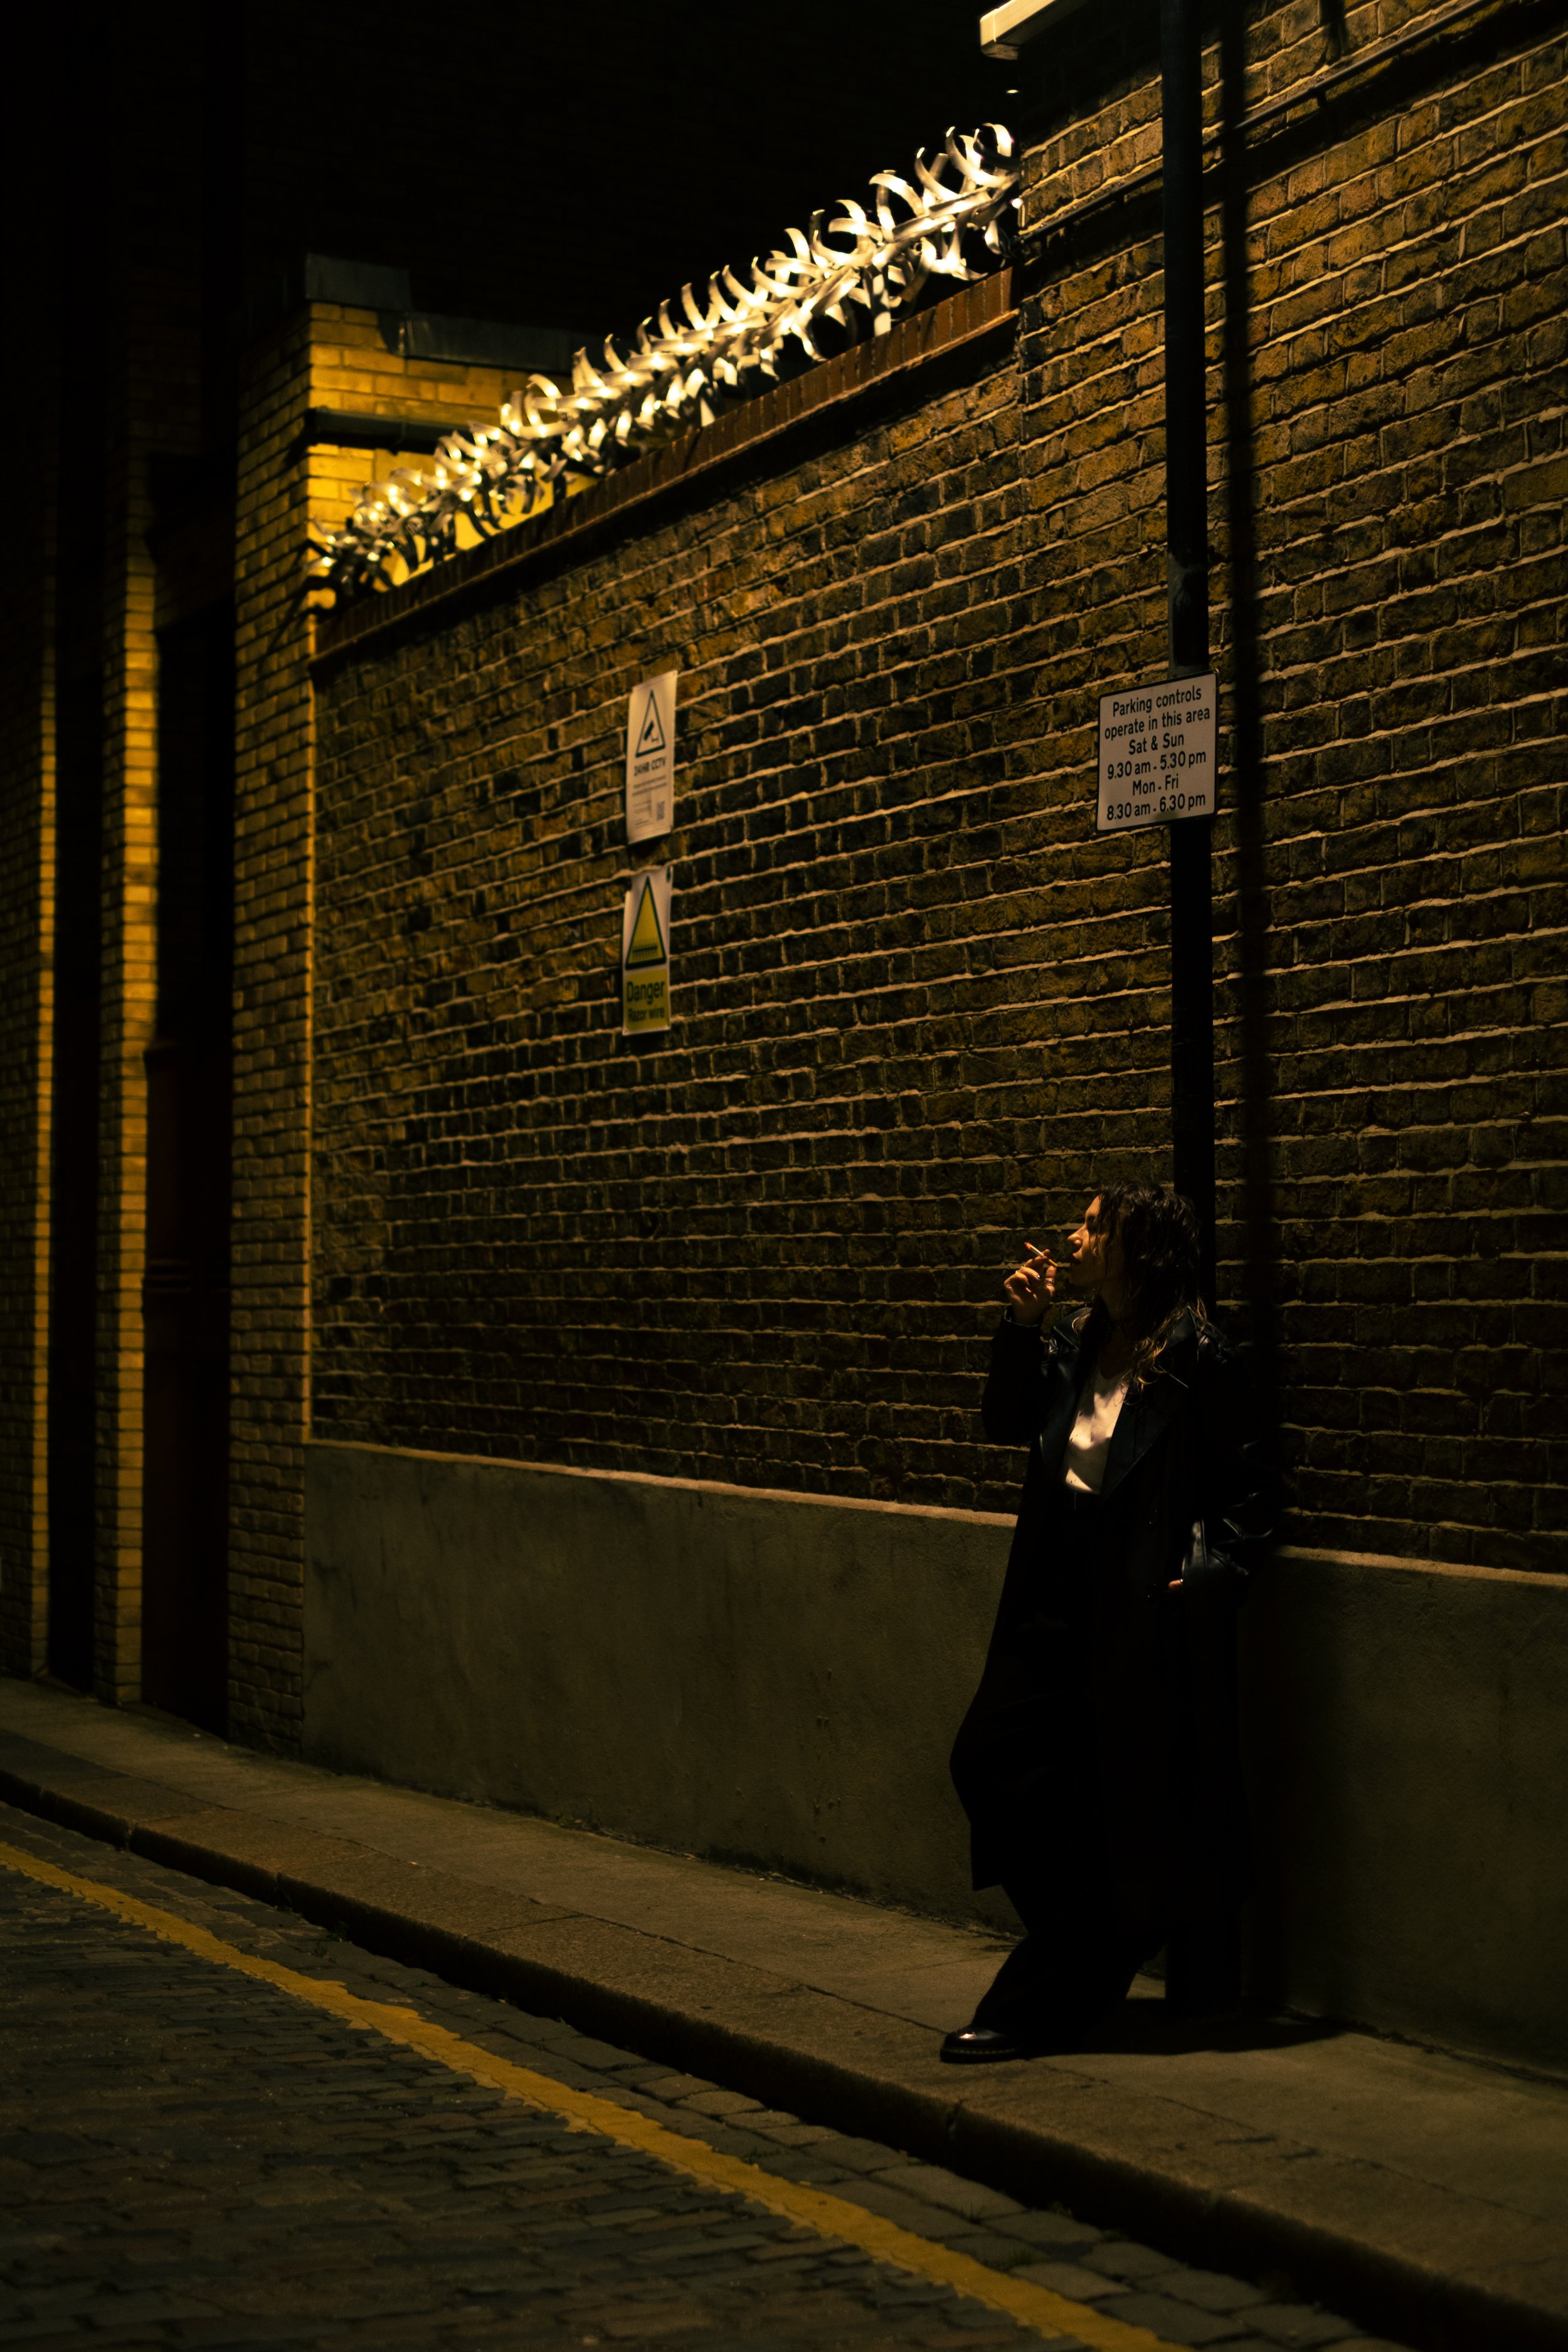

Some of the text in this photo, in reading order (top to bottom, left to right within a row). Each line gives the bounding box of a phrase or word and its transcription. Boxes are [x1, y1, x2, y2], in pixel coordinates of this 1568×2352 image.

[1113, 686, 1202, 717] Parking controls
[1104, 707, 1210, 741] operate in this area
[1129, 733, 1184, 755] Sat & Sun
[652, 756, 667, 771] CCTV
[1108, 761, 1131, 780] 9.30
[1135, 761, 1150, 775] am
[1160, 751, 1185, 770] 5.30
[1189, 751, 1206, 768] pm
[1133, 780, 1155, 795] Mon
[1165, 774, 1179, 790] Fri
[1107, 802, 1131, 820] 8.30
[1135, 803, 1150, 817] am
[1160, 793, 1185, 812] 6.30
[1189, 794, 1205, 810] pm
[627, 980, 665, 1005] Danger
[628, 1005, 665, 1022] Razor wire
